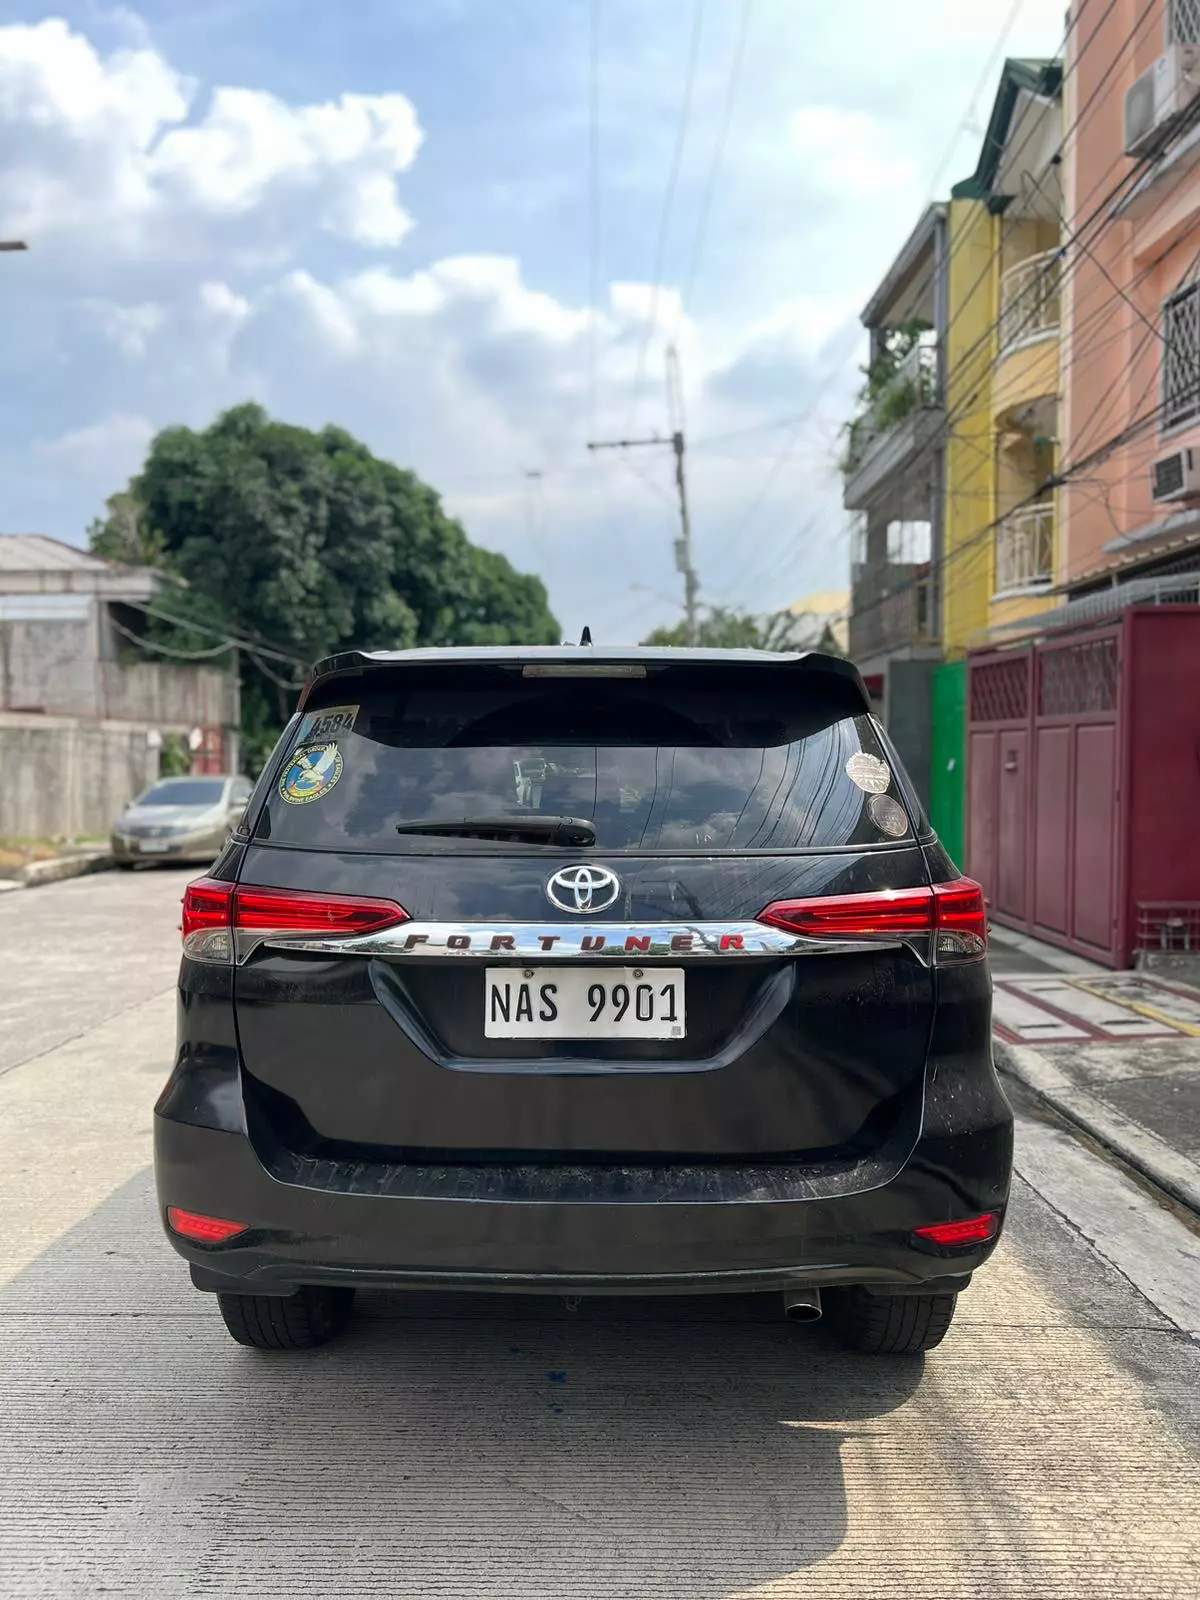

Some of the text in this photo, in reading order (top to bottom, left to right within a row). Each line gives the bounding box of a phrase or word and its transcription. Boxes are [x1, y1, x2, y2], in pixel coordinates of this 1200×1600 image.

[312, 713, 354, 735] 4584
[403, 934, 746, 951] FORTUNER
[491, 983, 678, 1022] NAS 9901
